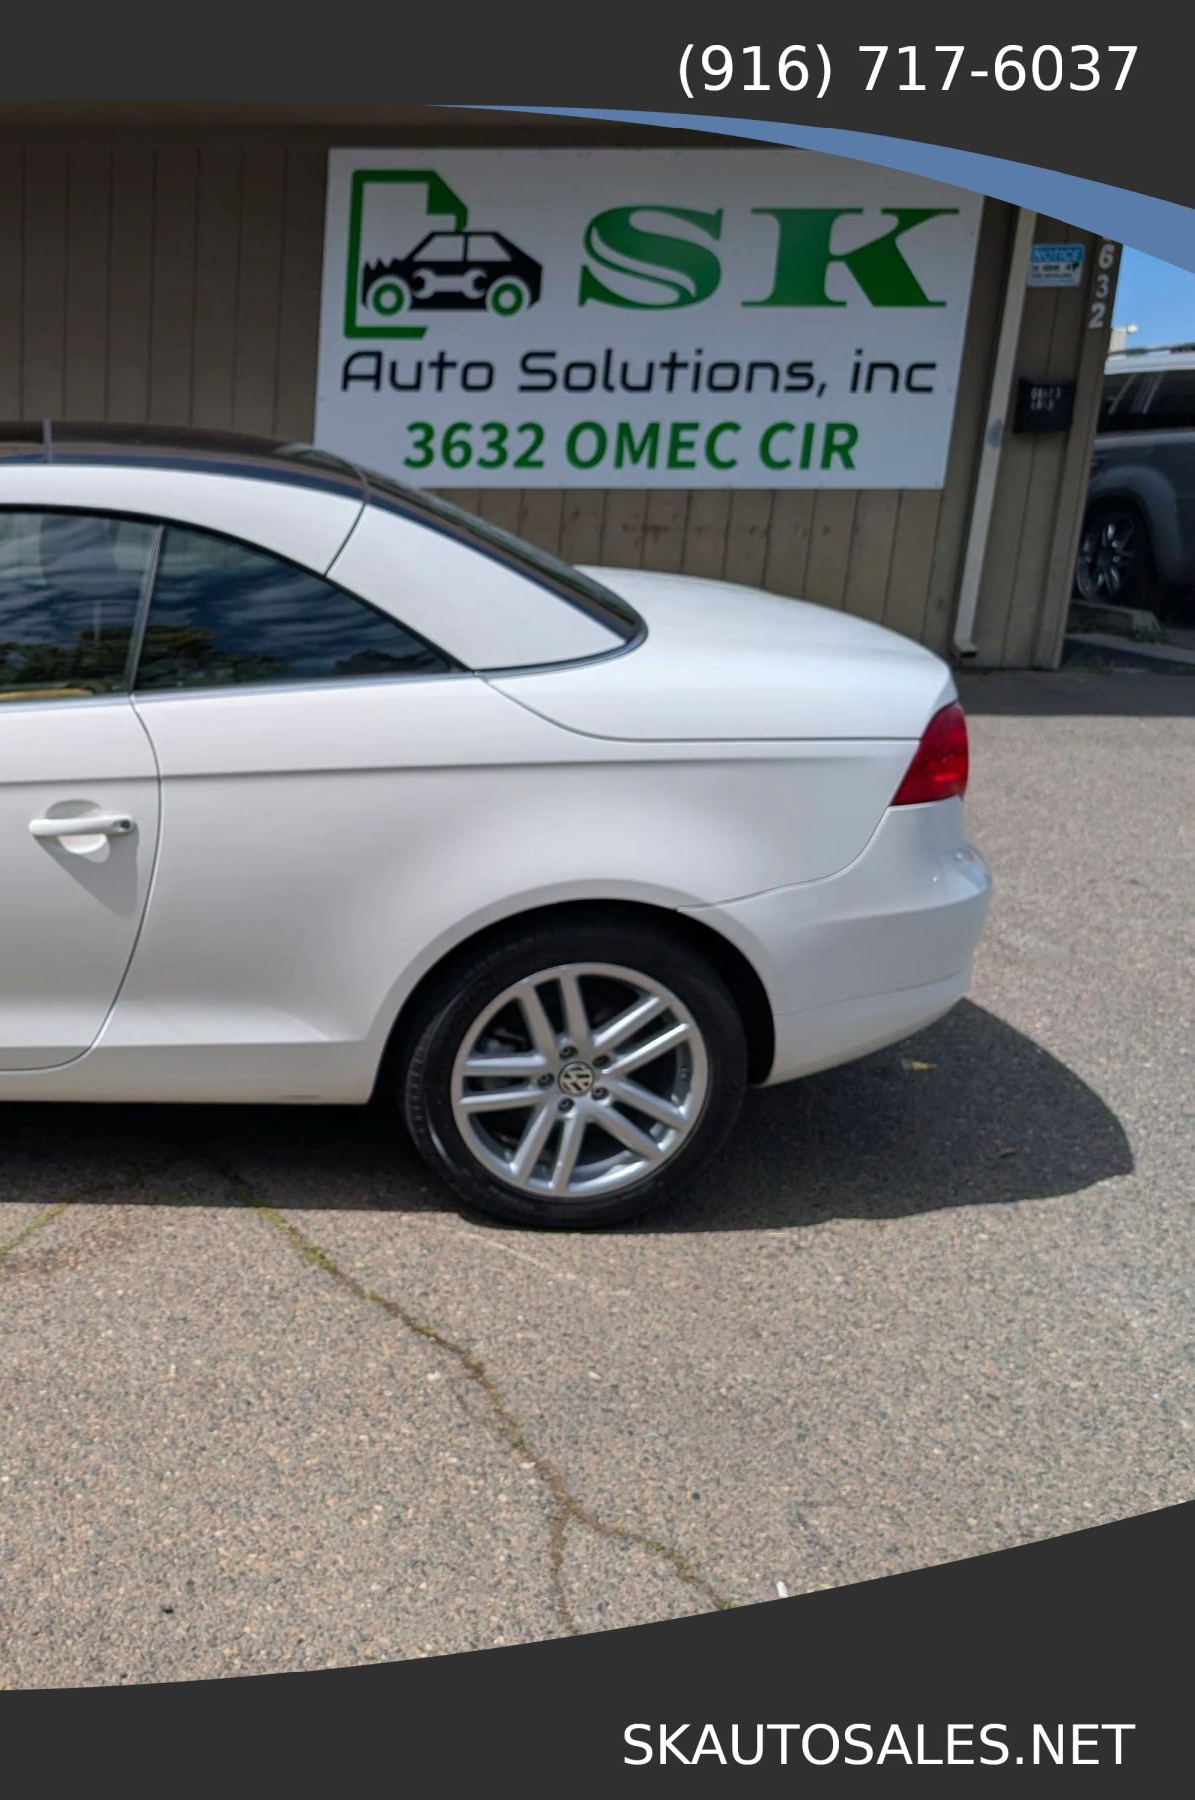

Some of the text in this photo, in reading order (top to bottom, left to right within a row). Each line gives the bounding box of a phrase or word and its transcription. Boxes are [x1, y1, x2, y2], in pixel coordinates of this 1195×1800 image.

[577, 205, 960, 311] SK
[1088, 237, 1115, 329] 632
[341, 347, 937, 398] Auto Solutions, inc
[403, 420, 860, 471] 3632 OMEC CIR
